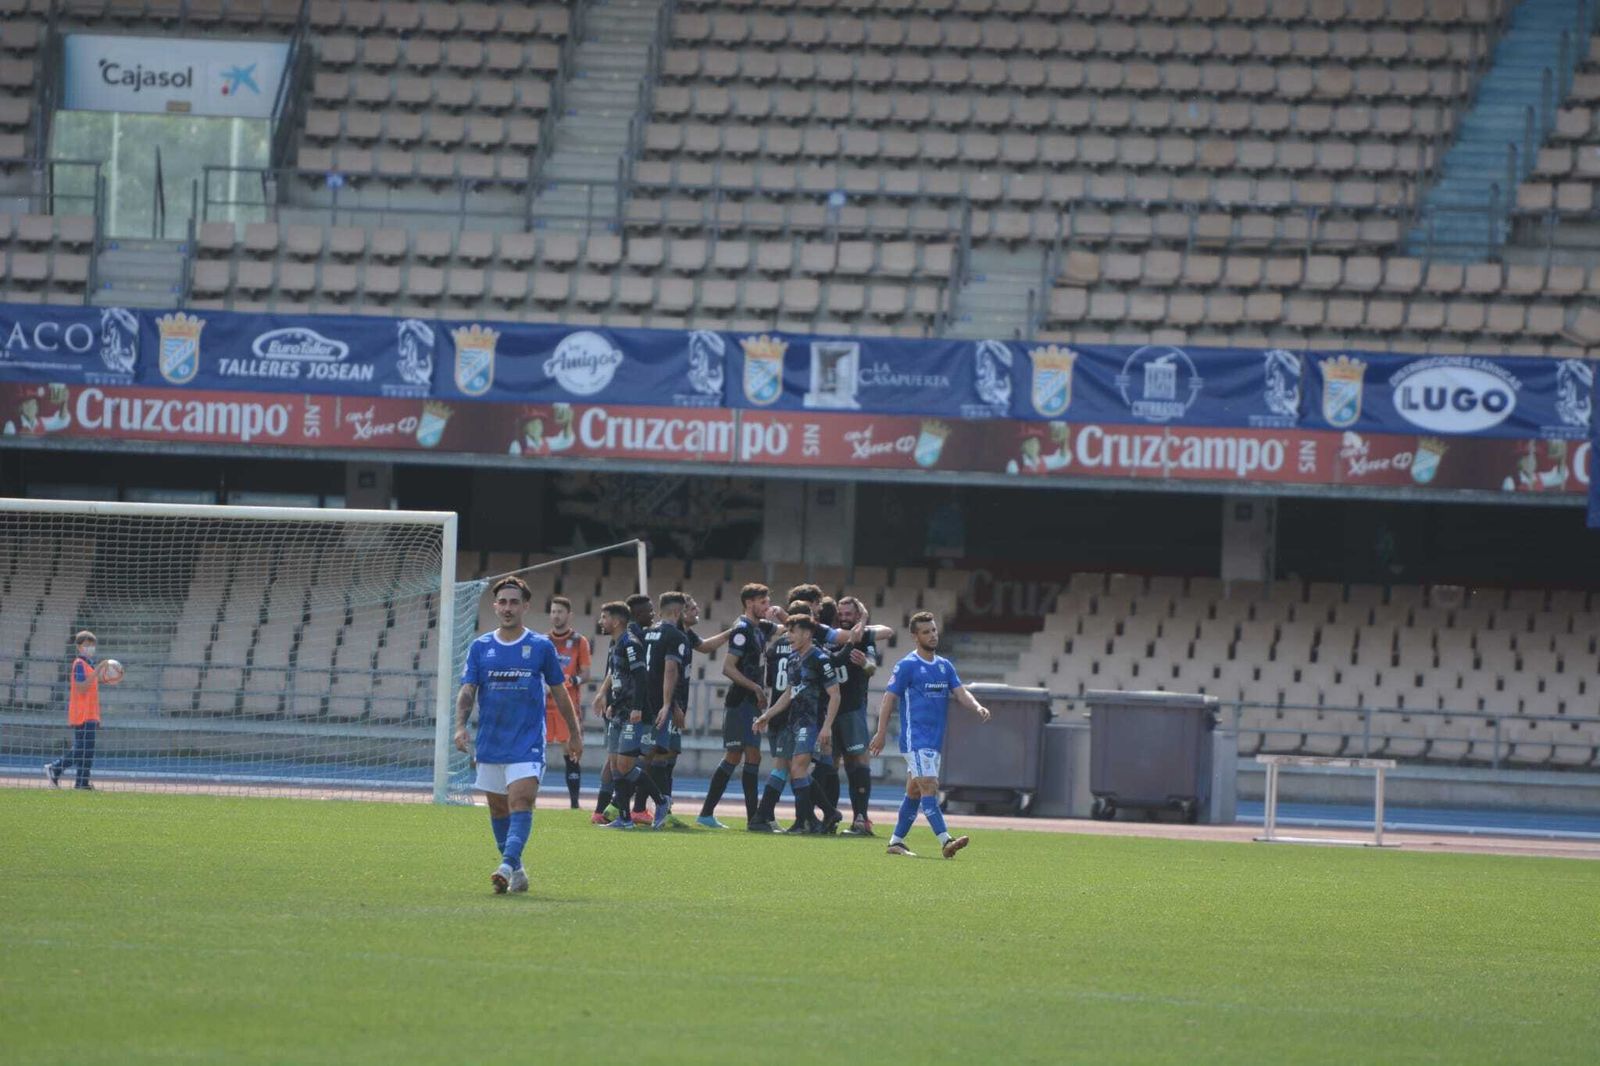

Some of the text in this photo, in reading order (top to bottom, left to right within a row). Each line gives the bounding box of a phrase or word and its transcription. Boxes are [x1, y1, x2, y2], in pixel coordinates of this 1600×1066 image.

[101, 62, 193, 92] Cajasol
[218, 358, 375, 382] TALLERES JOSEAN
[546, 350, 618, 375] Amigos
[75, 388, 321, 442] Cruzcampo SIN
[1401, 385, 1509, 414] LUGO
[579, 407, 821, 461] Cruzcampo SIN
[1076, 425, 1317, 477] Cruzcampo SIN
[776, 658, 788, 692] 6
